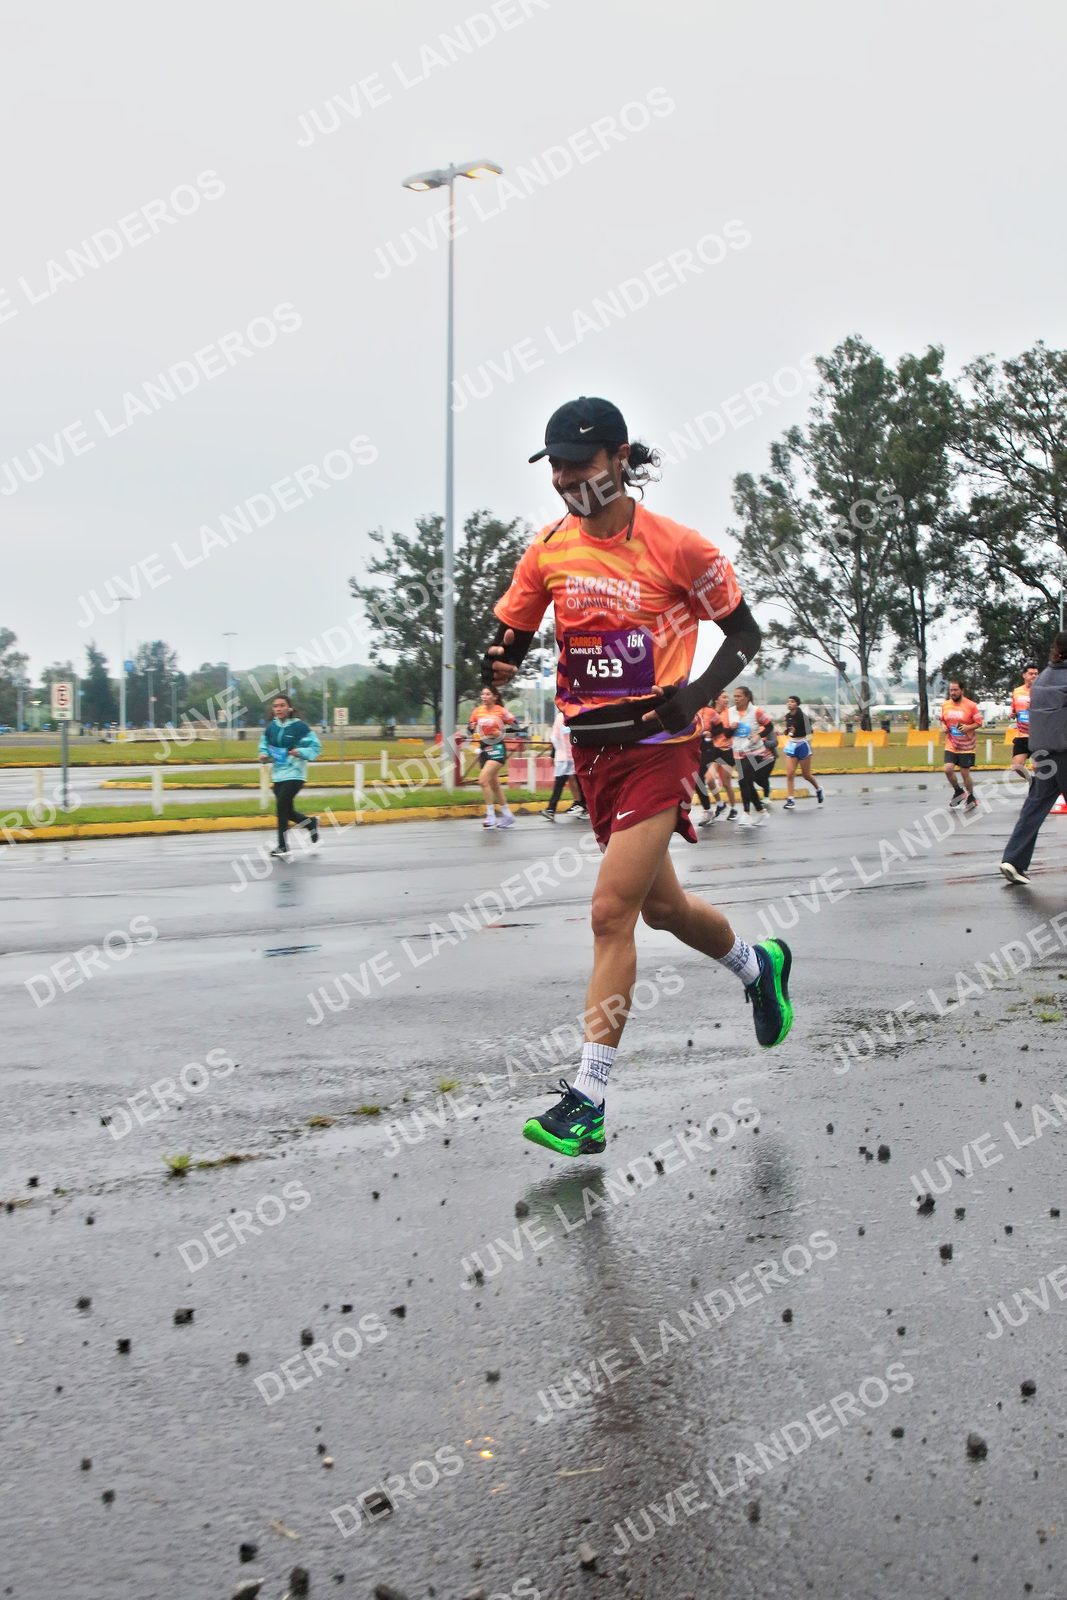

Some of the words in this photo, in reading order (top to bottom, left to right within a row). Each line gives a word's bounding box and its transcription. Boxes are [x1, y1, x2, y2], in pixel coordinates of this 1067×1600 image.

[565, 575, 641, 598] CARRERA
[627, 634, 645, 648] 15K
[586, 658, 624, 678] 453
